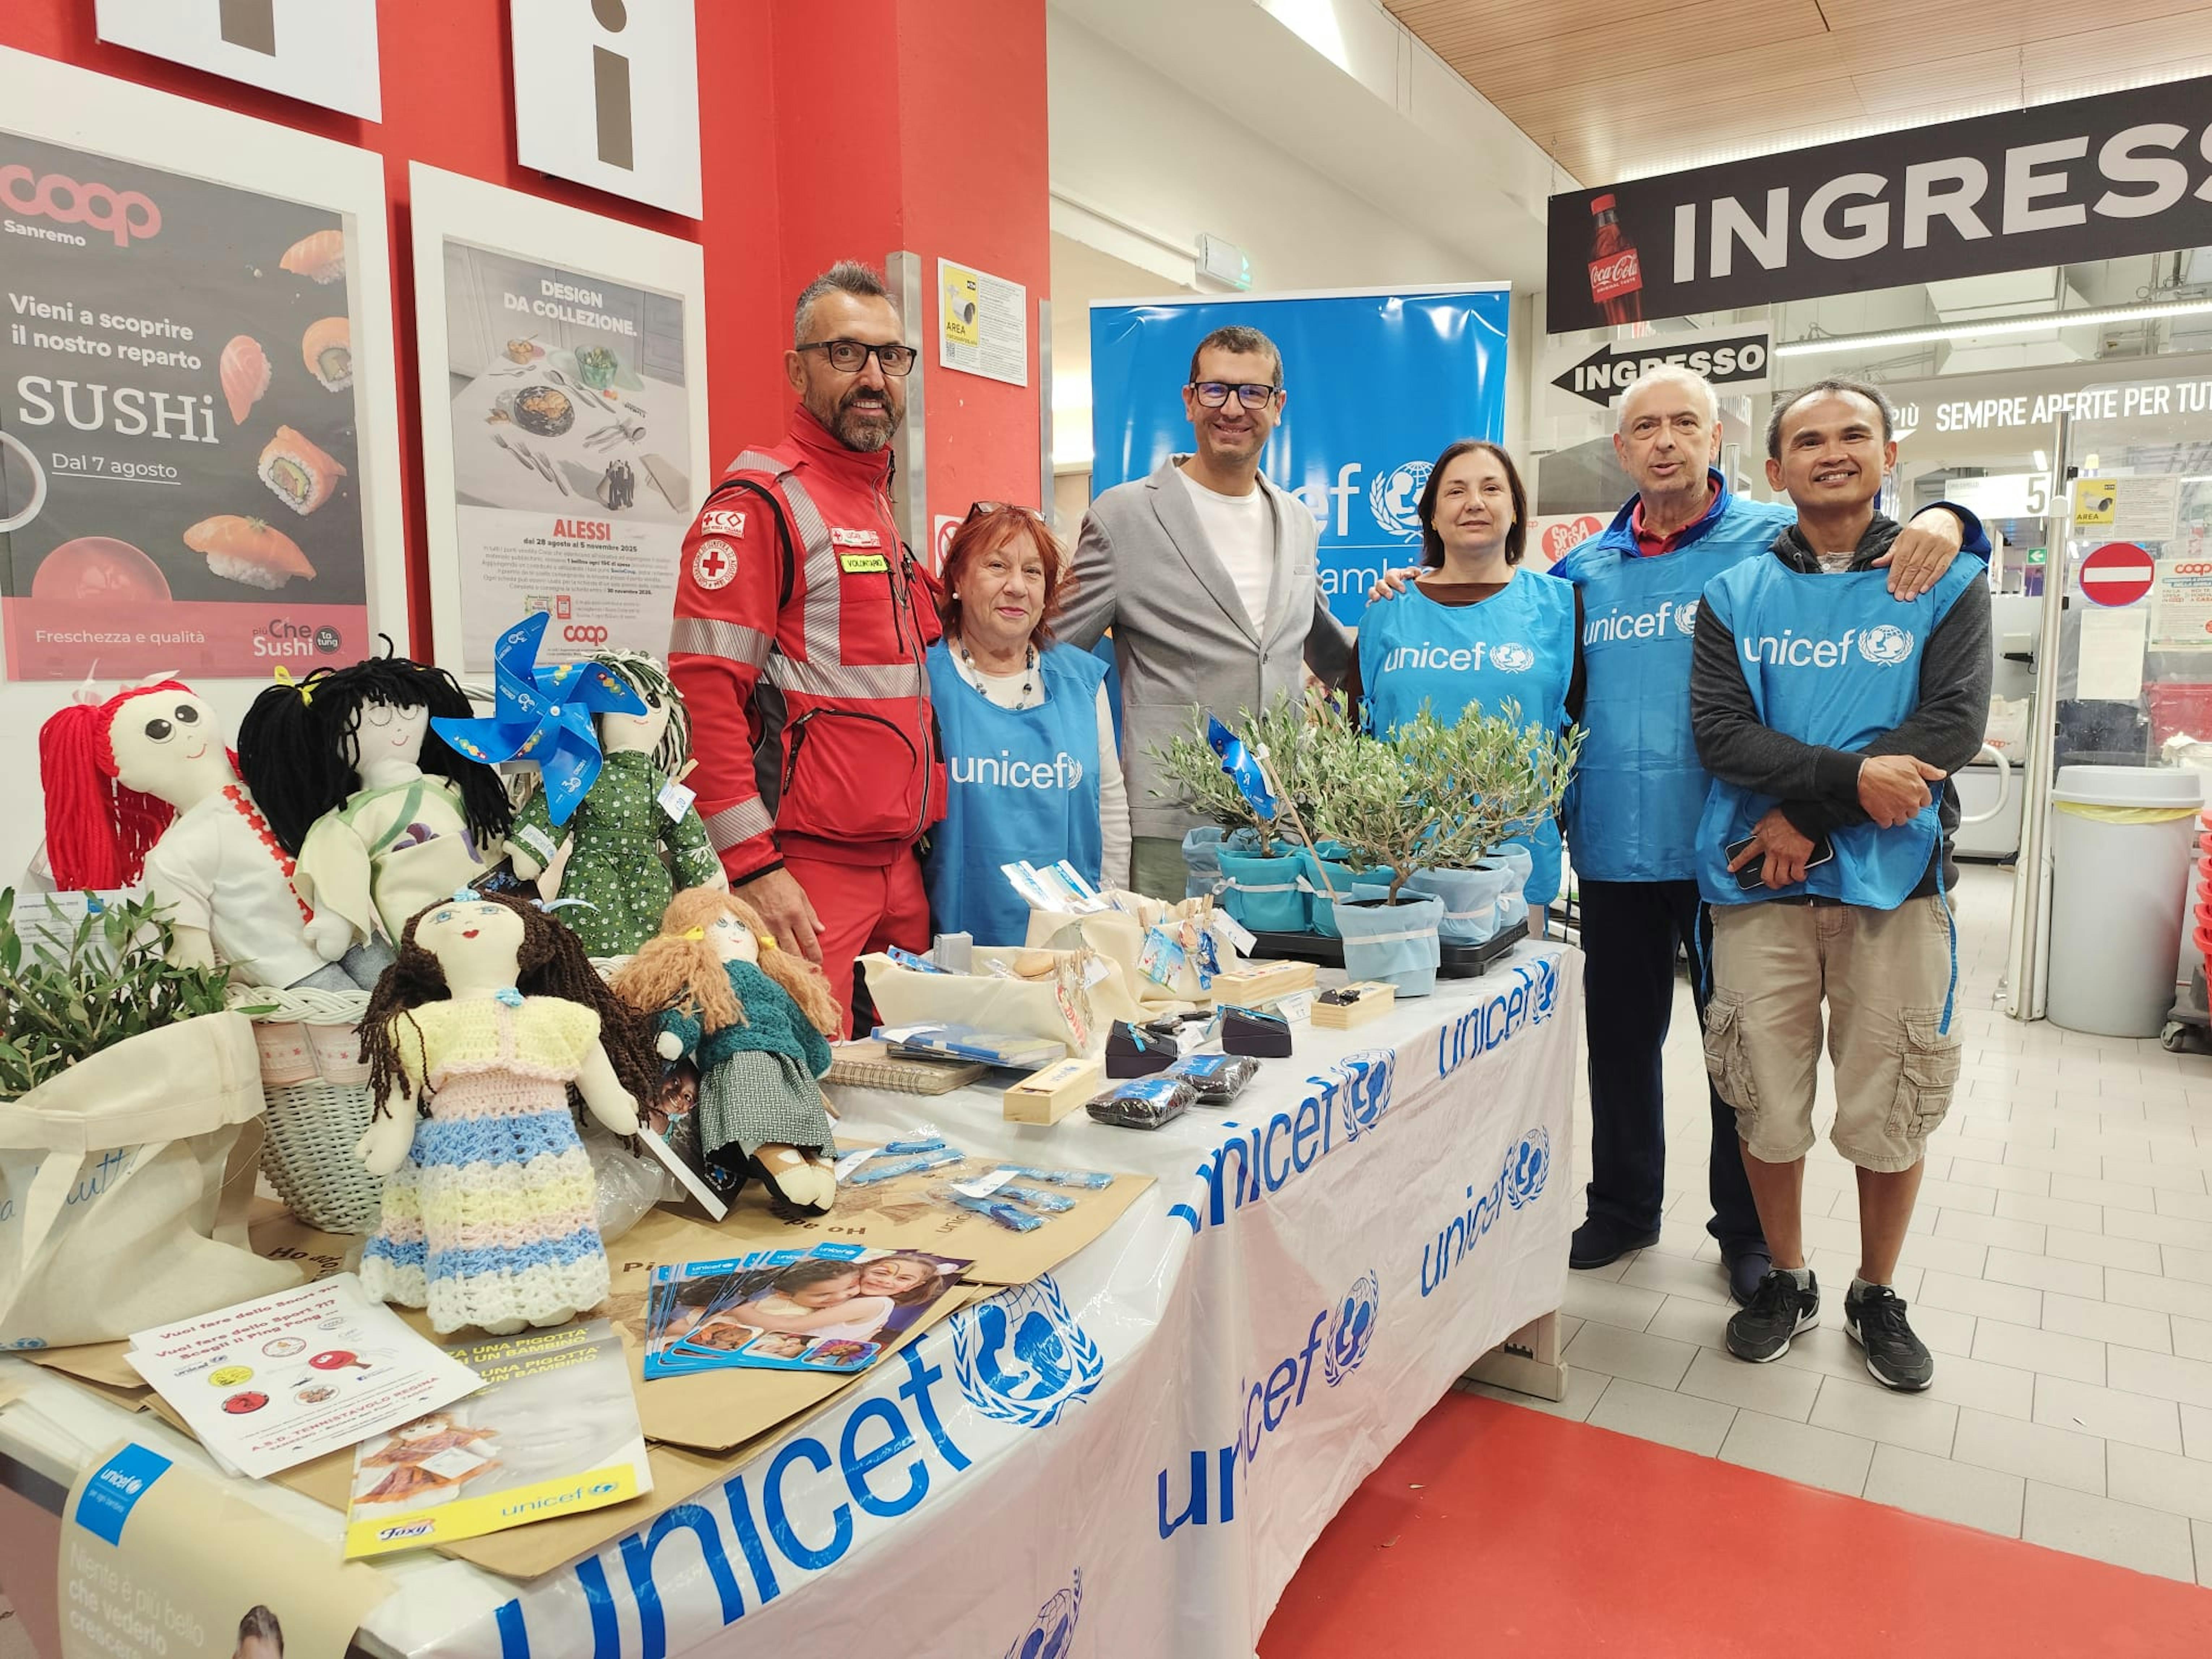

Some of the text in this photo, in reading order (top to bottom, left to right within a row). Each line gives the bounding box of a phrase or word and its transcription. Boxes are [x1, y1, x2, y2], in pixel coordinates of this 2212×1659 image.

[0, 164, 162, 248] coop
[1674, 123, 2212, 284] INGRES
[4, 220, 86, 247] Sanremo
[1591, 255, 1637, 288] Coca-Cola
[541, 279, 603, 308] DESIGN
[9, 292, 194, 341] Vieni a scoprire
[504, 292, 637, 337] DA COLLEZIONE.
[947, 322, 965, 336] AREA
[11, 324, 202, 370] il nostro reparto
[17, 376, 219, 444] SUSHi
[1936, 396, 2027, 432] SEMPRE
[2031, 389, 2118, 423] APERTE
[2124, 385, 2170, 416] PER
[52, 452, 178, 480] Dal 7 agosto
[2027, 476, 2046, 514] 5
[553, 519, 611, 541] ALESSI
[2175, 563, 2212, 576] coop
[35, 629, 205, 646] Freschezza e qualità
[269, 619, 312, 638] Che
[564, 625, 608, 646] coop
[1583, 601, 1673, 645] unicef
[253, 636, 313, 656] Sushi
[317, 639, 338, 647] tung
[1384, 641, 1486, 671] unicef
[1744, 628, 1856, 668] unicef
[951, 750, 1068, 789] unicef
[1440, 968, 1534, 1080] unicef
[1421, 1146, 1513, 1298] unicef
[268, 1248, 308, 1259] Ho
[195, 1333, 228, 1346] fare
[232, 1322, 269, 1336] dello
[272, 1308, 312, 1323] Sport
[472, 1342, 511, 1354] UNA
[474, 1353, 501, 1362] UN
[481, 1365, 520, 1377] UNA
[294, 1396, 391, 1435] TENNISTAVOLO
[393, 1376, 440, 1398] REGINA
[1158, 1309, 1328, 1540] unicef
[100, 1468, 135, 1491] unicef
[492, 1334, 972, 1659] unicef
[502, 1488, 583, 1517] unicef
[381, 1525, 427, 1540] Foxy
[72, 1542, 205, 1647] Niente è più bello
[69, 1578, 167, 1656] che vederlo
